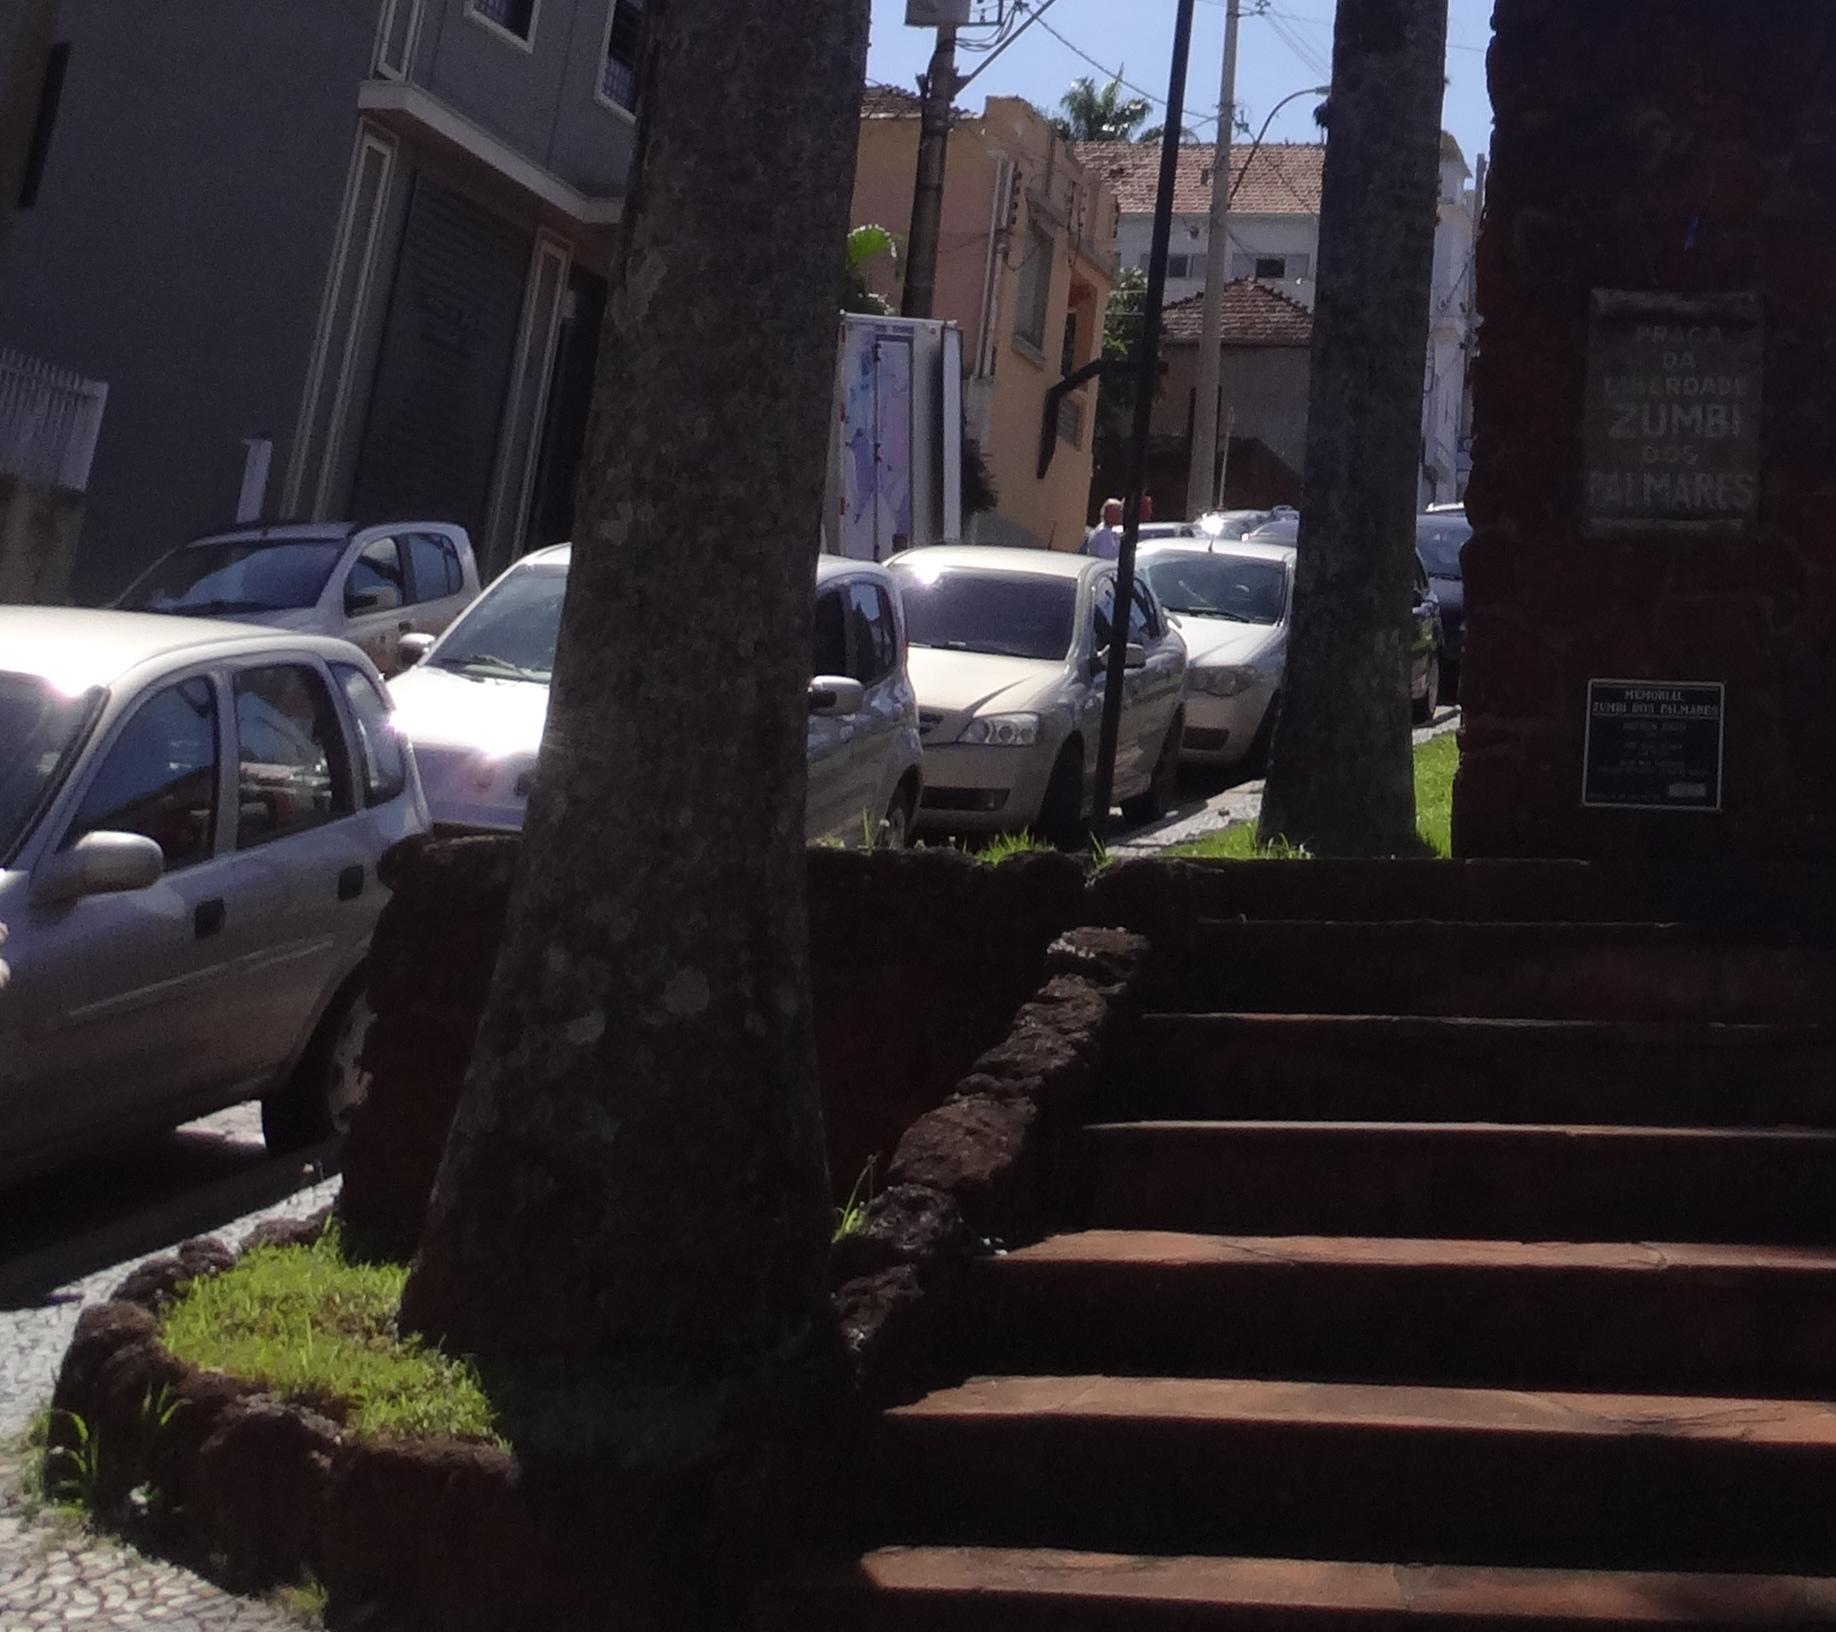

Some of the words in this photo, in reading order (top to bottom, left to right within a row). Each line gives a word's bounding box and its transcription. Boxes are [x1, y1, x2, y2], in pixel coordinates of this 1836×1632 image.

[1663, 351, 1696, 369] DA
[1604, 376, 1749, 396] LIBERDADE
[1609, 403, 1741, 438] ZUMBI
[1642, 444, 1699, 465] DOS
[1590, 472, 1755, 511] PALMARES
[1624, 689, 1684, 702] MEMORIAL
[1591, 701, 1627, 713] ZUMBI
[1631, 702, 1655, 713] DOS
[1660, 703, 1719, 715] PALMARES
